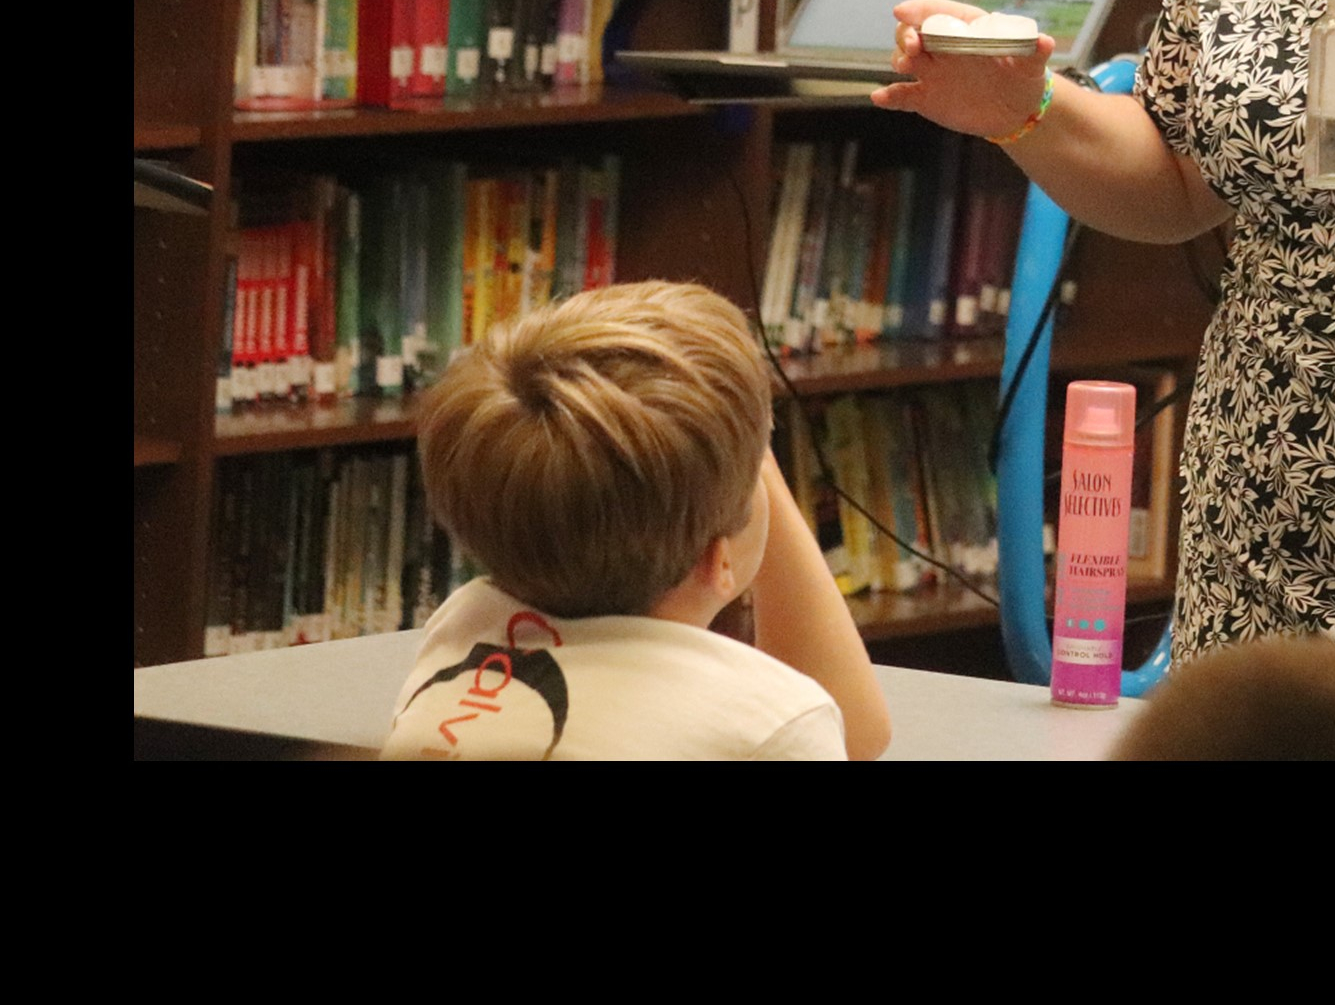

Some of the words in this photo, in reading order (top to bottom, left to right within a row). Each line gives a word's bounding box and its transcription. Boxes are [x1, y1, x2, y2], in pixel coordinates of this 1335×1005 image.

[1072, 469, 1112, 492] SALON
[1064, 492, 1122, 517] SELECTIVES
[1070, 553, 1122, 565] FLEXIBLE
